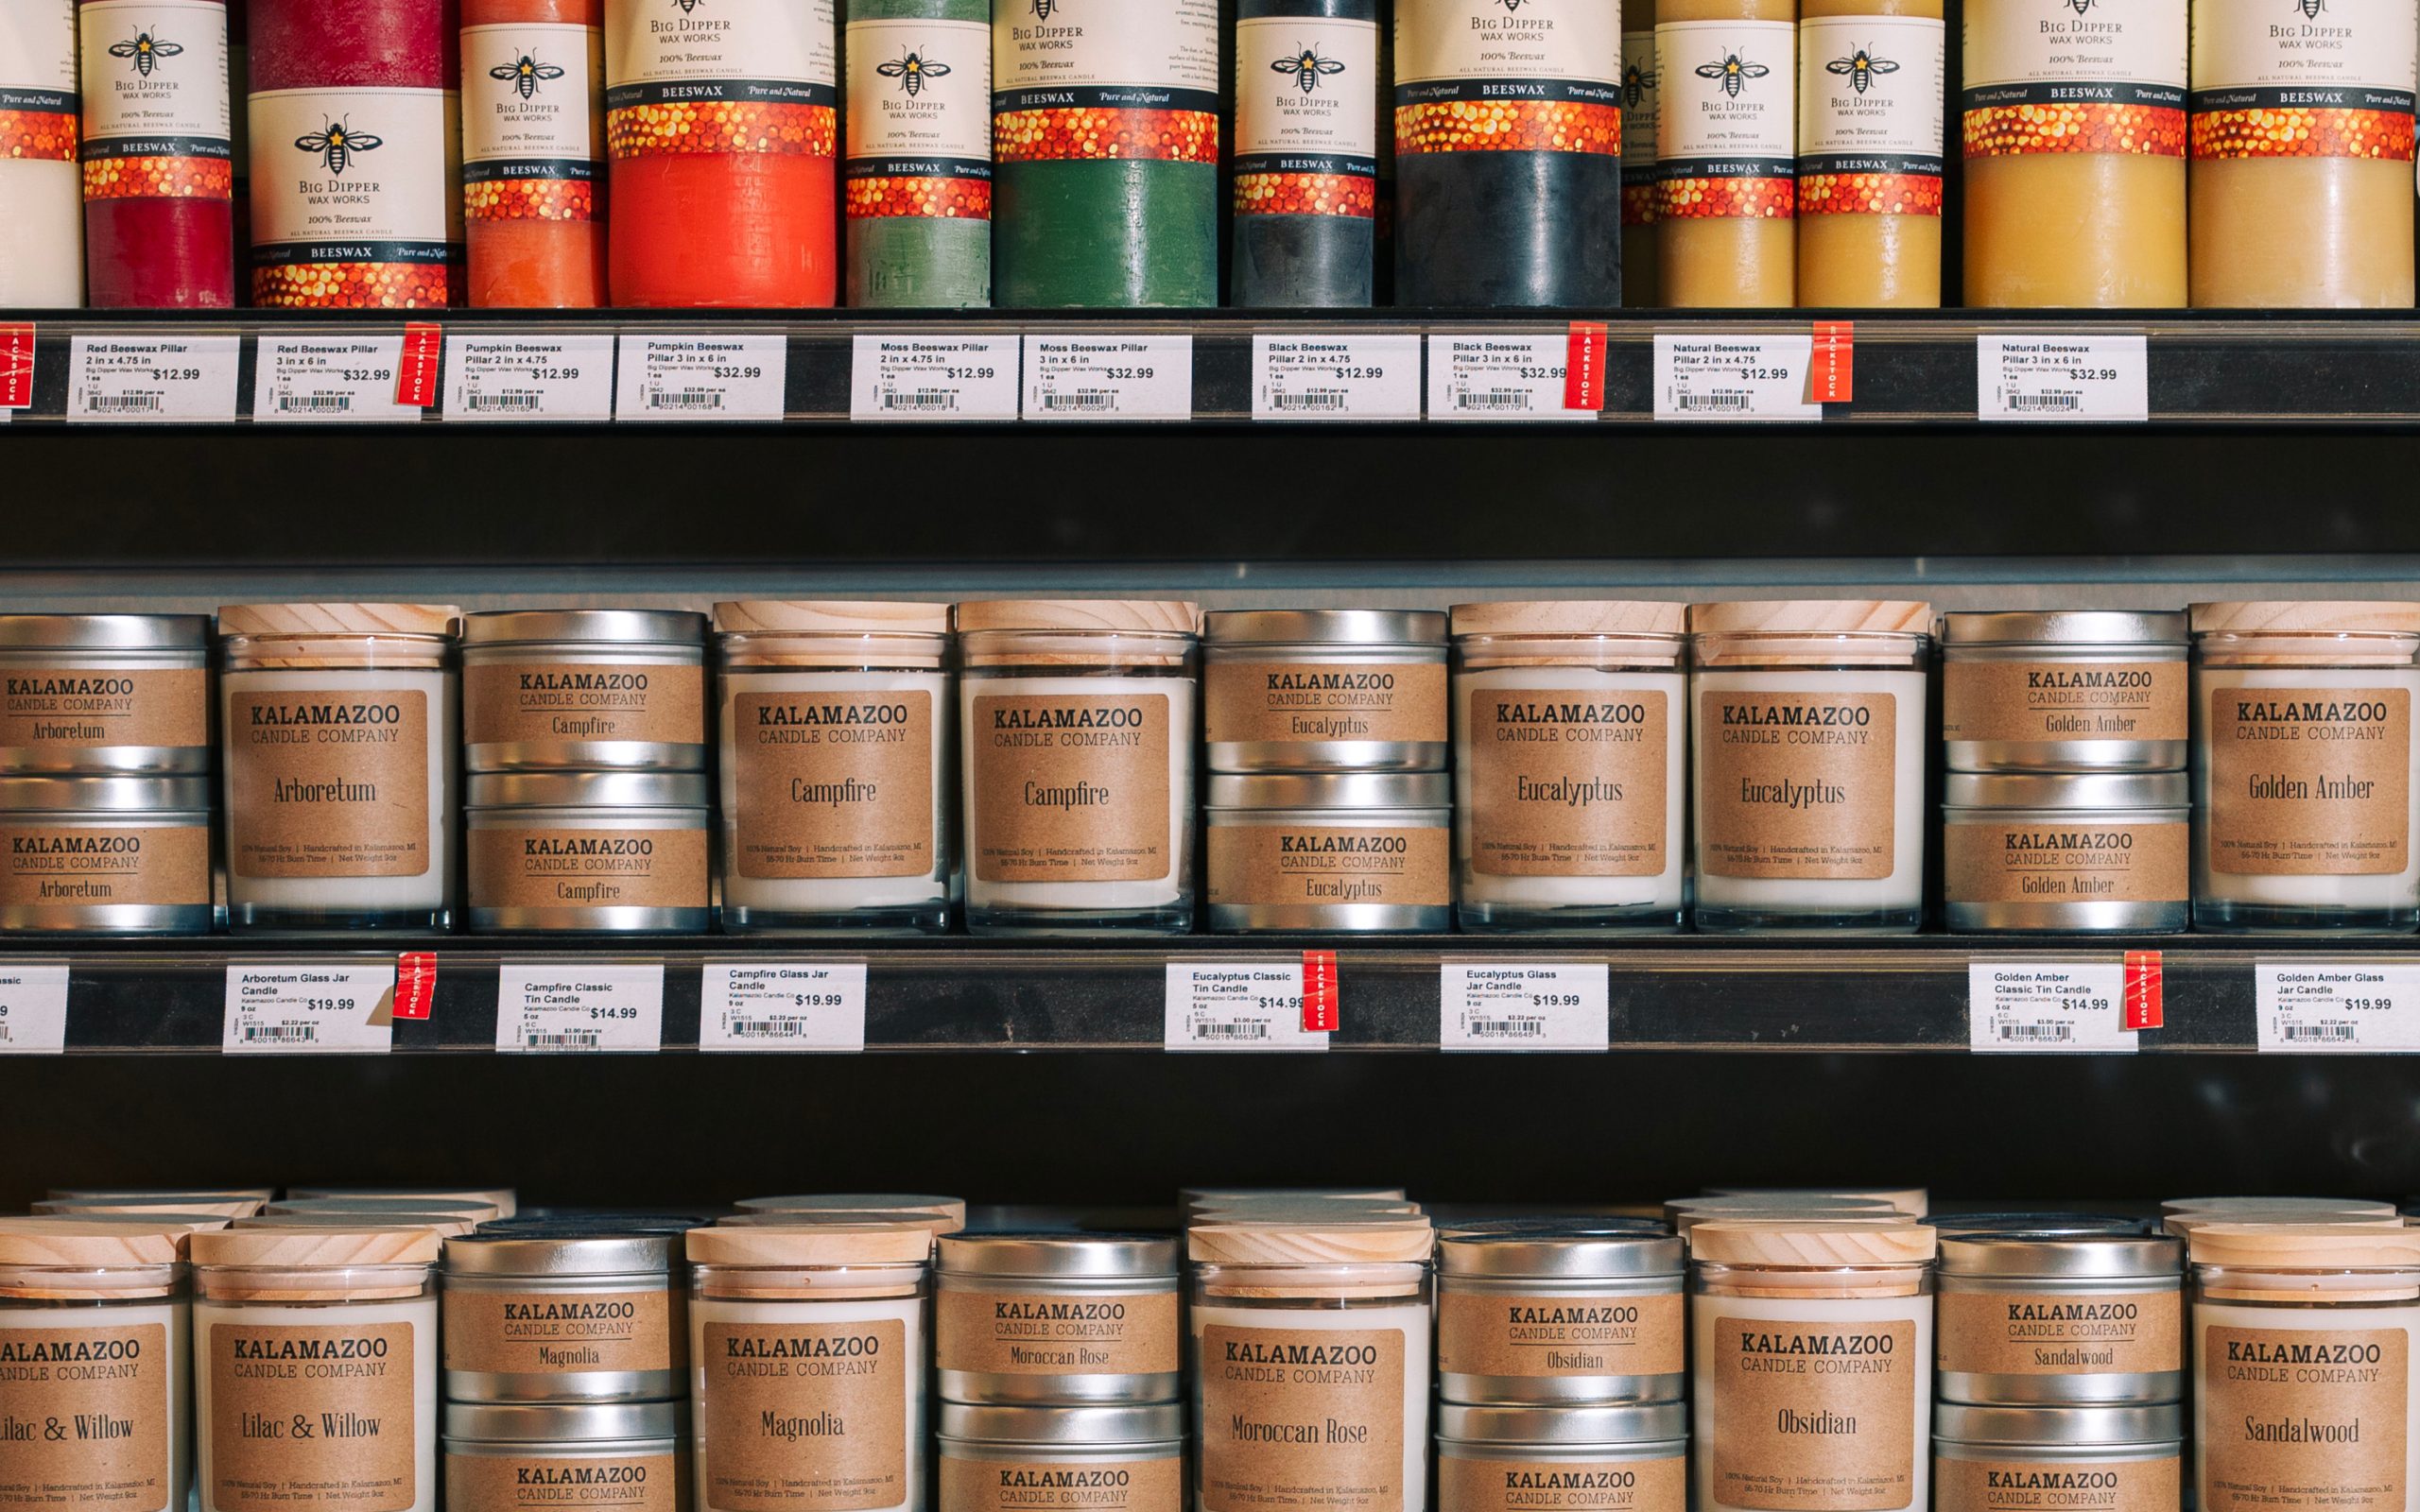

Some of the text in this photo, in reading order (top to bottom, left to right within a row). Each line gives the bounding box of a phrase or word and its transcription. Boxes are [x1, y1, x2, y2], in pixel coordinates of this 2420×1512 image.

[659, 33, 720, 43] WAX WORKS
[1480, 32, 1544, 42] WAX WORKS
[2278, 40, 2342, 49] WAX WORKS
[660, 53, 721, 63] 100% Beeswax
[2307, 60, 2342, 68] Beeswax
[663, 85, 722, 97] BEESWAX
[748, 85, 811, 97] Pure and Natural
[1482, 84, 1545, 94] BEESWAX
[2280, 93, 2342, 103] BEESWAX
[123, 143, 178, 153] BEESWAX
[308, 195, 370, 204] WAX WORKS
[308, 215, 372, 224] 100% Beeswax
[312, 248, 372, 257] BEESWAX
[87, 344, 187, 353] Red Beeswax Pillar
[648, 342, 744, 352] Pumpkin Beeswax
[1269, 343, 1348, 352] Black Beeswax
[2043, 344, 2089, 352] Beeswax
[86, 356, 93, 365] 2
[95, 356, 105, 365] in
[117, 356, 138, 365] 4.75
[142, 356, 151, 365] in
[648, 353, 674, 362] Pillar
[677, 353, 683, 363] 3
[708, 354, 714, 363] 6
[1269, 354, 1295, 363] Pillar
[2002, 355, 2029, 364] Pillar
[2031, 355, 2038, 364] 3
[2063, 355, 2069, 365] 6
[2072, 356, 2082, 365] in
[1581, 326, 1592, 406] BACKSTOCK
[152, 369, 200, 381] $12.99
[714, 367, 760, 378] $32.99
[1336, 367, 1383, 379] $12.99
[2069, 369, 2117, 380] $32.99
[520, 674, 648, 690] KALAMAZOO
[520, 694, 647, 706] CANDLE COMPANY
[252, 705, 400, 725] KALAMAZOO
[1724, 706, 1870, 726] KALAMAZOO
[2238, 702, 2387, 722] KALAMAZOO
[553, 716, 614, 737] Campfire
[251, 728, 399, 744] CANDLE COMPANY
[1723, 730, 1868, 745] CANDLE COMPANY
[2237, 726, 2385, 741] CANDLE COMPANY
[274, 777, 376, 802] Arboretum
[2250, 774, 2375, 799] Golden Amber
[1742, 778, 1845, 809] Eucalyptus
[2006, 833, 2133, 850] KALAMAZOO
[1770, 845, 1819, 853] Handcrafted
[2005, 852, 2131, 866] CANDLE COMPANY
[2022, 876, 2115, 894] Golden Amber
[730, 970, 828, 980] Campfire Glass Jar
[1467, 970, 1557, 981] Eucalyptus Glass
[1995, 972, 2069, 982] Golden Amber
[729, 981, 766, 990] Candle
[1317, 955, 1325, 1027] BACKSTOCK
[1466, 981, 1522, 990] Jar Candle
[1995, 985, 2091, 994] Classic Tin Candle
[795, 994, 841, 1005] $19.99
[1533, 994, 1580, 1006] $19.99
[2062, 998, 2108, 1010] $14.99
[505, 1302, 634, 1319] KALAMAZOO
[1510, 1306, 1638, 1324] KALAMAZOO
[505, 1321, 633, 1336] CANDLE COMPANY
[1509, 1327, 1637, 1340] CANDLE COMPANY
[234, 1338, 388, 1359] KALAMAZOO
[1226, 1342, 1376, 1365] KALAMAZOO
[2228, 1342, 2380, 1364] KALAMAZOO
[540, 1346, 599, 1366] Magnolia
[1547, 1351, 1603, 1368] Obsidian
[235, 1362, 387, 1379] CANDLE COMPANY
[1225, 1366, 1374, 1383] CANDLE COMPANY
[2227, 1366, 2379, 1383] CANDLE COMPANY
[243, 1412, 381, 1438] Lilac & Willow
[1233, 1415, 1367, 1444] Moroccan Rose
[2246, 1416, 2359, 1443] Sandalwood
